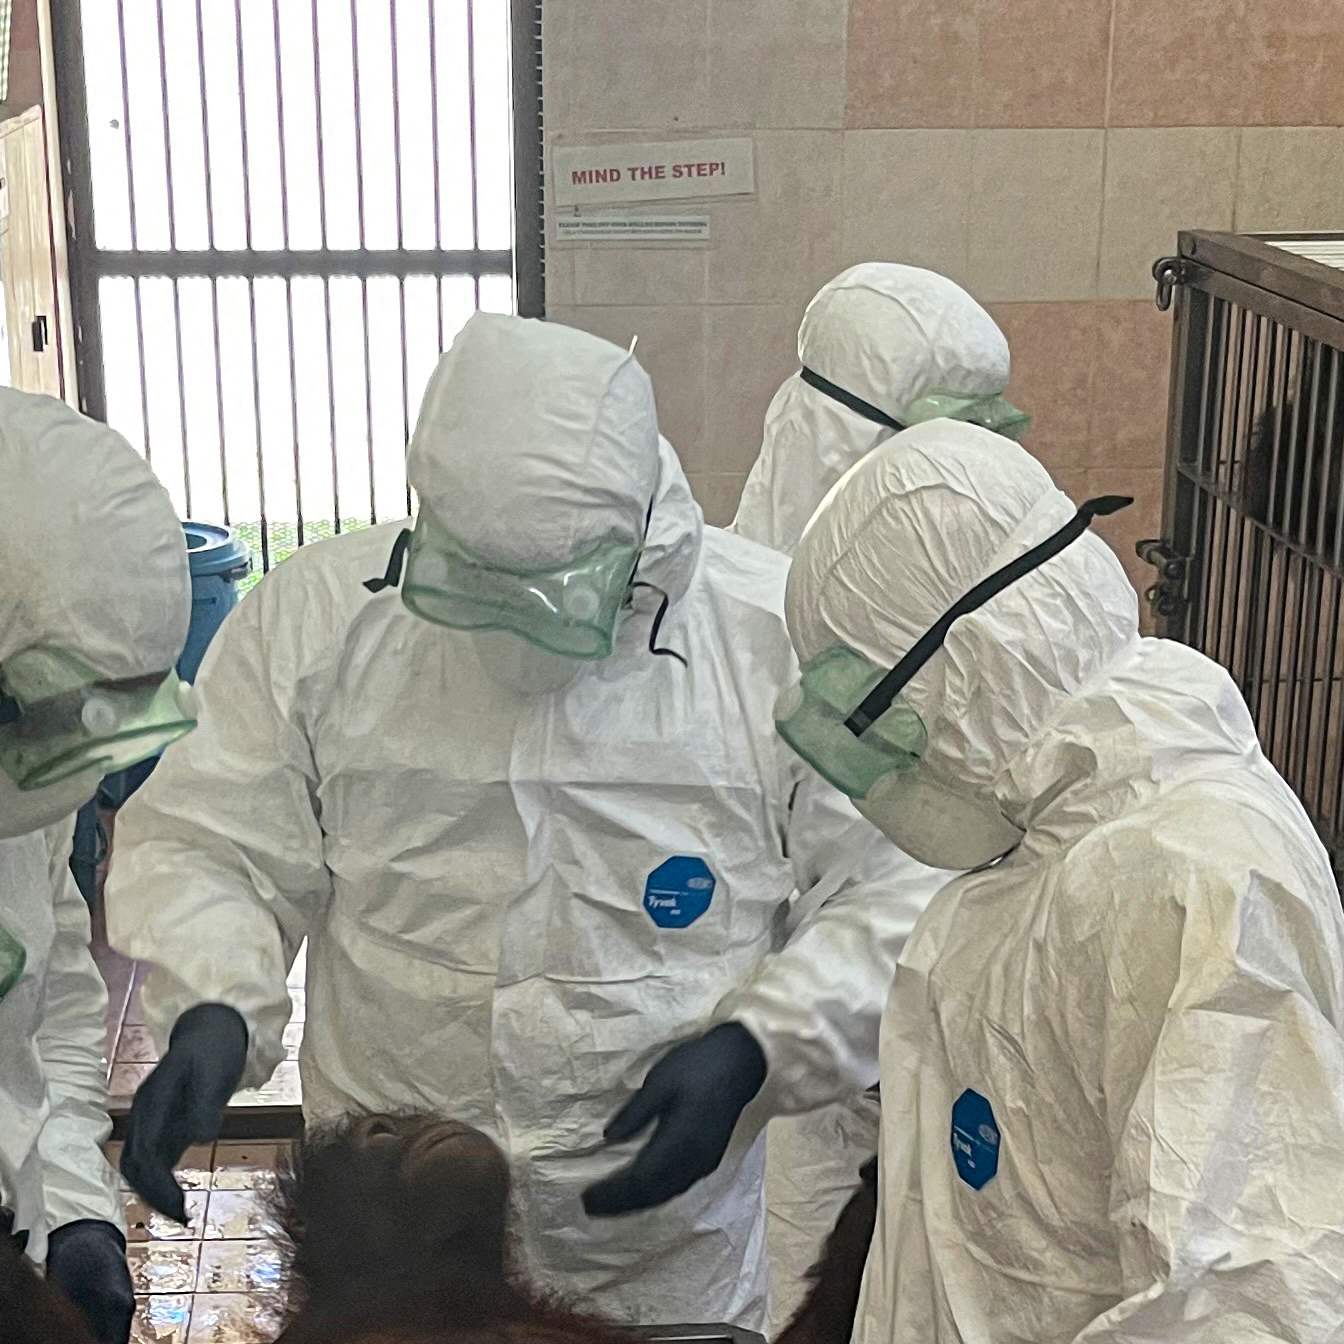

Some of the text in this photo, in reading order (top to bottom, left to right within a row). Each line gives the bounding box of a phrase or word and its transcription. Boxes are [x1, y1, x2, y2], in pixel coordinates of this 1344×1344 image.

[572, 161, 726, 185] MIND THE STEP!
